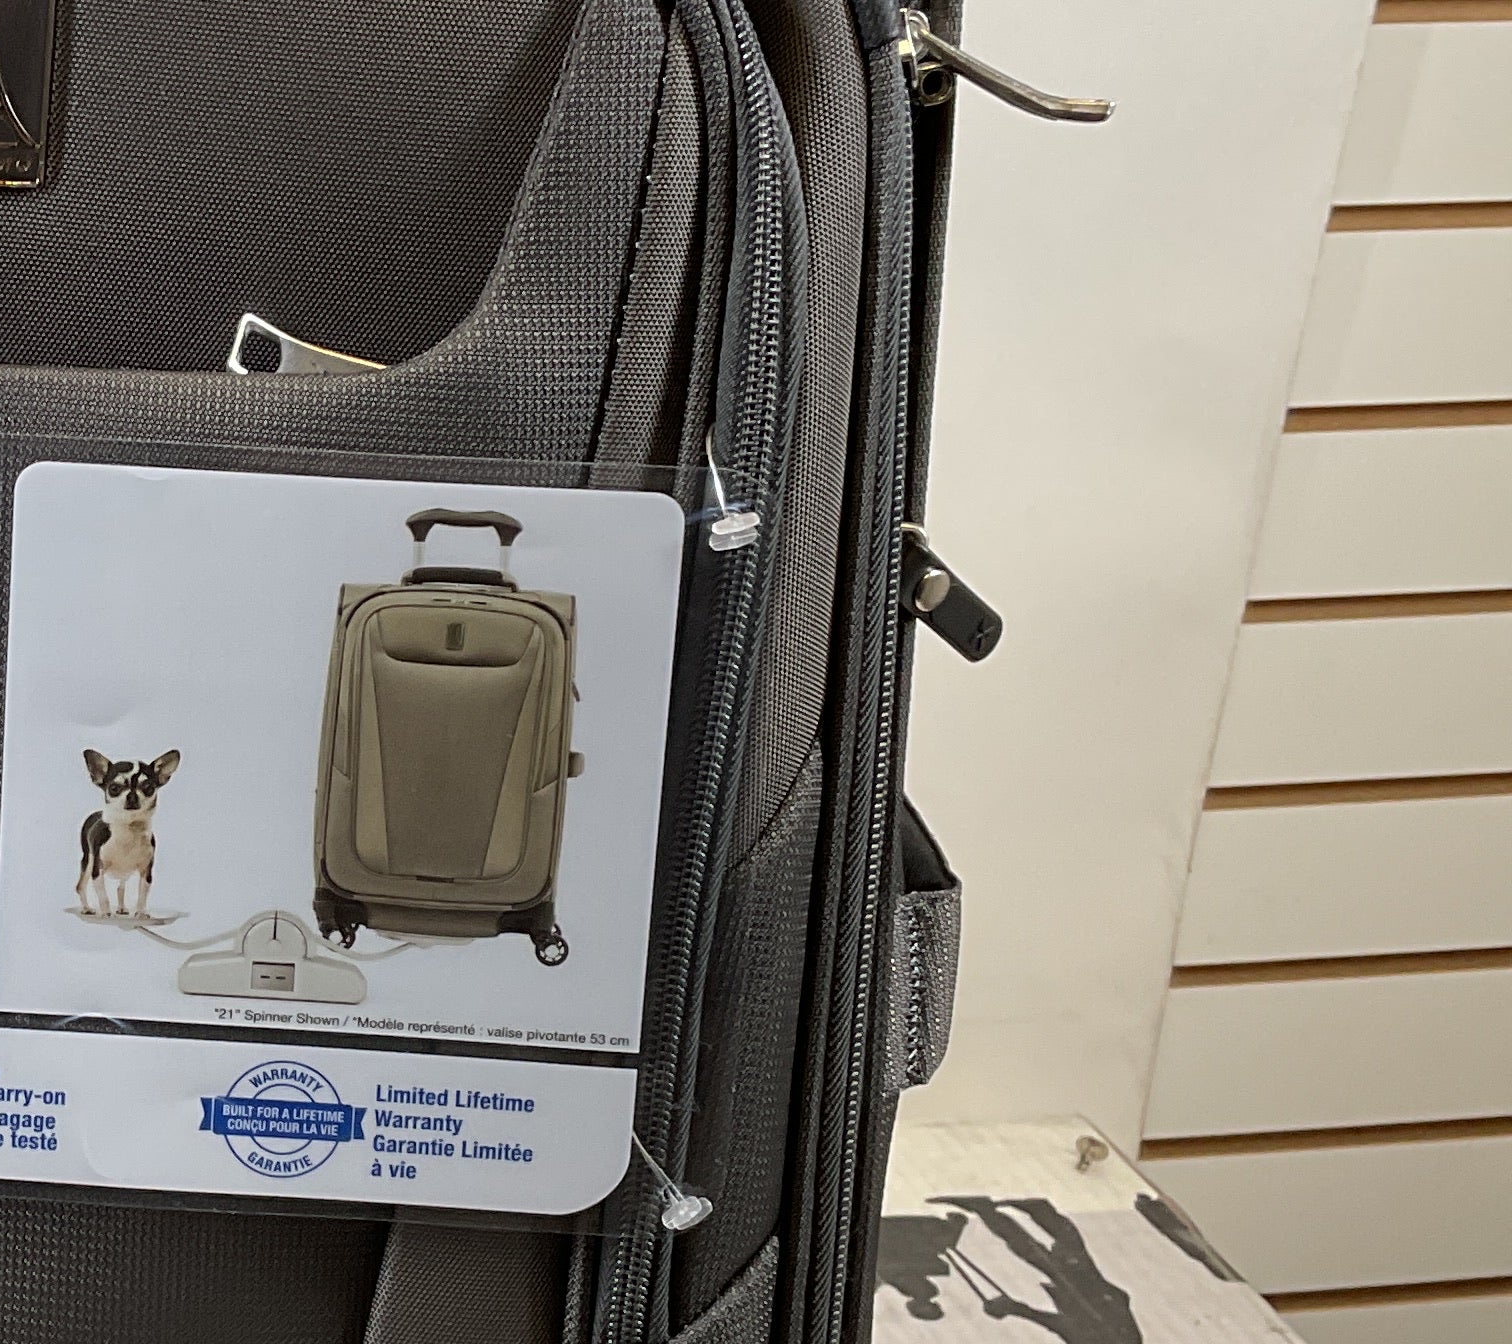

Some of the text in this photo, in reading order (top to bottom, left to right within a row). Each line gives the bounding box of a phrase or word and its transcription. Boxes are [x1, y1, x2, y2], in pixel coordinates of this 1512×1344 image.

[244, 1010, 292, 1023] Spinner
[296, 1012, 340, 1026] Shown
[408, 1022, 476, 1036] représenté
[487, 1026, 523, 1039] valise
[526, 1029, 586, 1044] pivotante
[590, 1034, 606, 1045] 53
[609, 1036, 630, 1046] cm
[249, 1068, 325, 1093] WARRANTY
[376, 1084, 535, 1113] Limited Lifetime
[222, 1104, 345, 1123] BUILT FOR A LIFETIME
[374, 1109, 463, 1136] Warranty
[227, 1118, 338, 1136] CONÇU POUR LA VIE
[10, 1130, 58, 1151] testé
[372, 1134, 534, 1163] Garantie Limitée
[247, 1151, 313, 1173] GARANTIE
[371, 1159, 417, 1179] à vie
